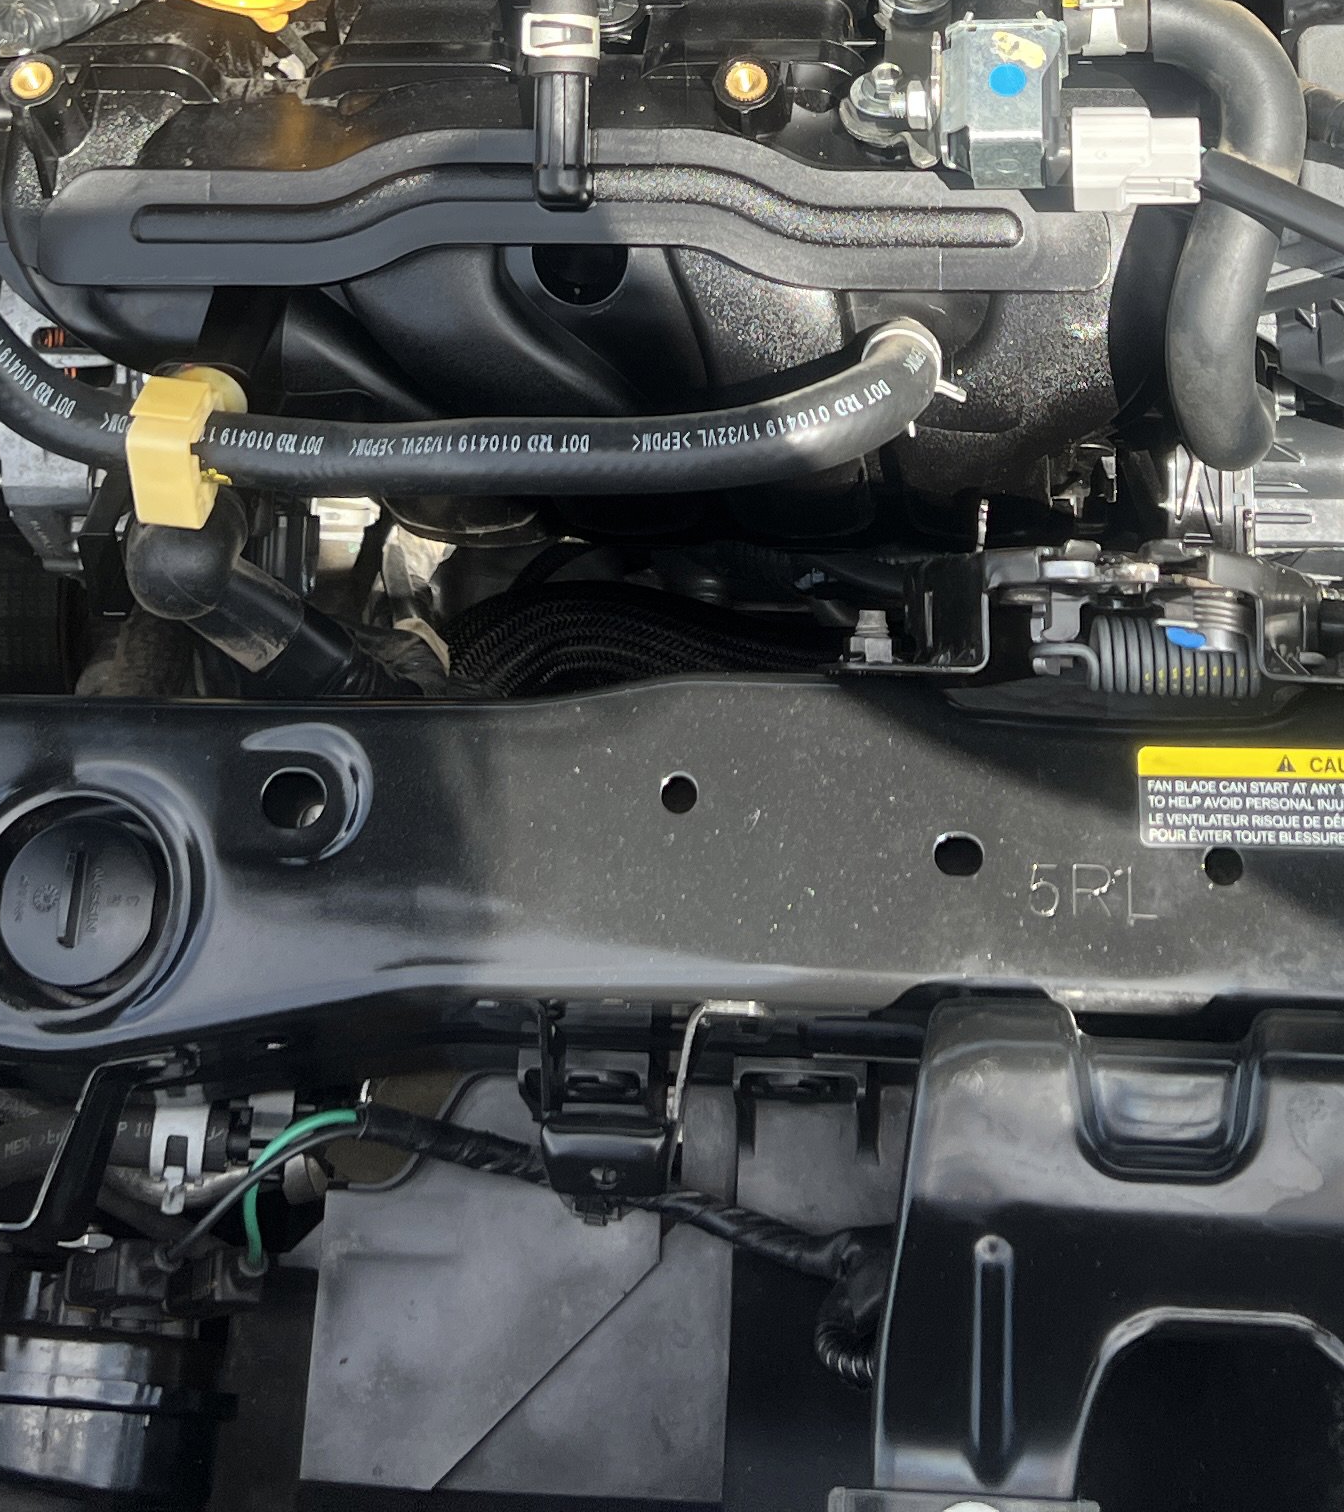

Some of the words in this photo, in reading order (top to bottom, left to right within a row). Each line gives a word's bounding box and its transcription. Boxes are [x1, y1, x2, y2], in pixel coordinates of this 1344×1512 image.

[861, 377, 893, 407] DOT
[50, 392, 78, 420] DOT
[298, 435, 325, 457] DOT
[559, 432, 590, 454] DOT
[1147, 779, 1172, 793] FAN
[1175, 780, 1217, 794] BLADE
[1219, 780, 1248, 794] CAN
[1250, 781, 1289, 795] START
[1291, 782, 1308, 795] AT
[1309, 782, 1337, 796] ANY
[1148, 794, 1166, 809] TO
[1168, 795, 1202, 809] HELP
[1203, 796, 1244, 810] AVOID
[1245, 797, 1315, 812] PERSONAL
[1148, 812, 1165, 826] LE
[1166, 813, 1249, 828] VENTILATEUR
[1251, 815, 1300, 830] RISQUE
[1303, 815, 1321, 829] DE
[1149, 828, 1186, 843] POUR
[1188, 825, 1233, 843] ÉVITER
[1235, 829, 1276, 844] TOUTE
[1029, 863, 1157, 921] 5RL
